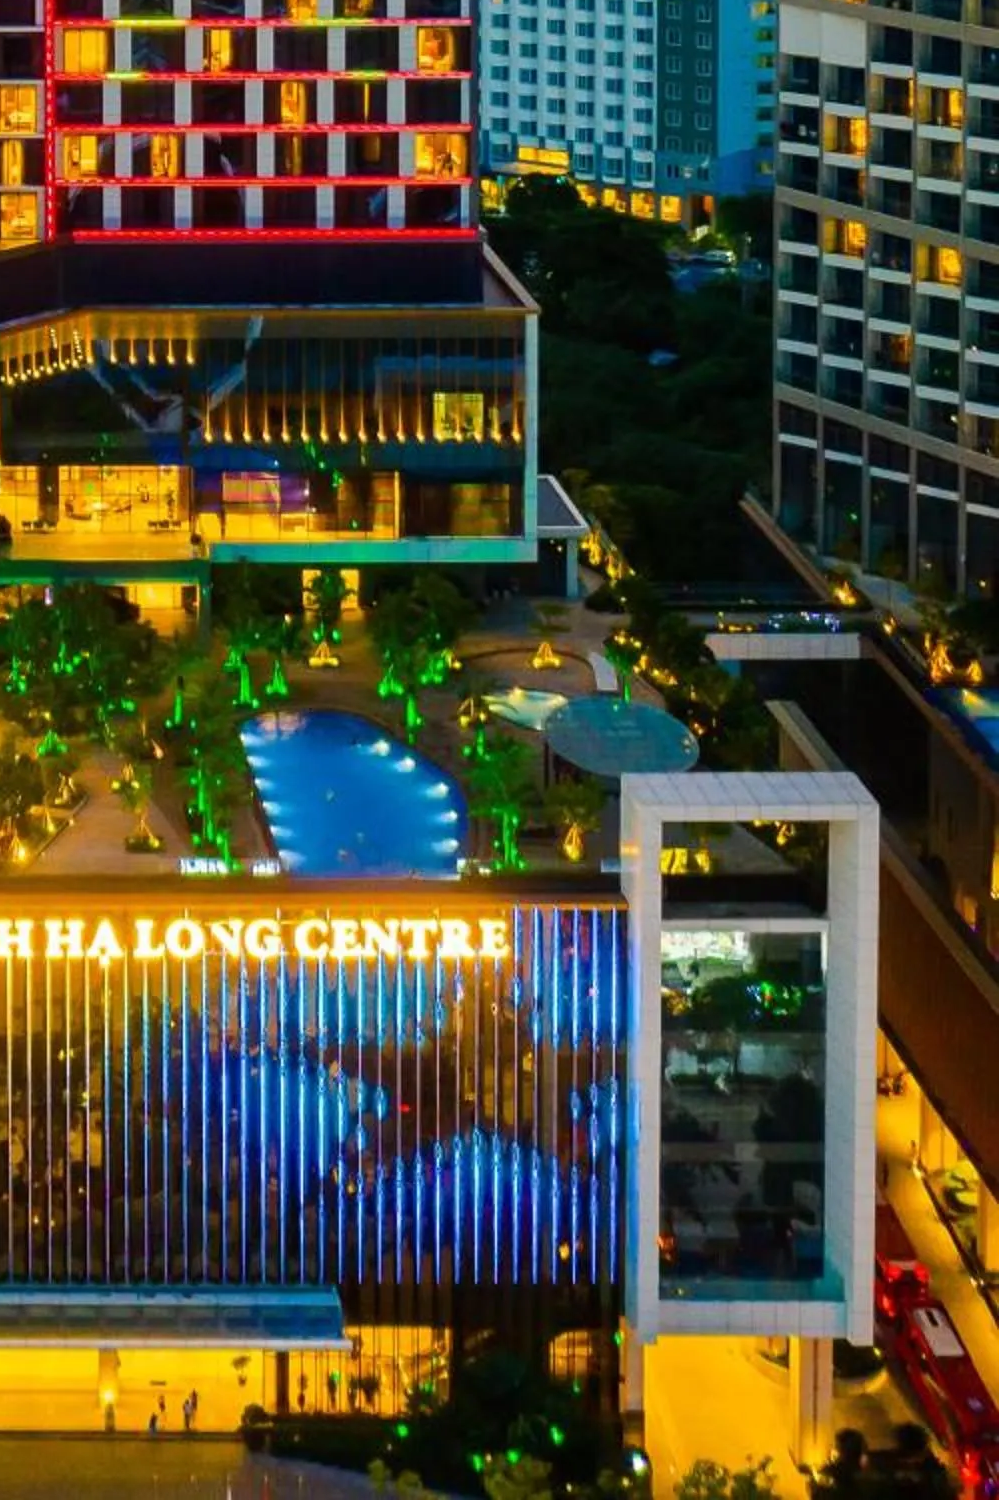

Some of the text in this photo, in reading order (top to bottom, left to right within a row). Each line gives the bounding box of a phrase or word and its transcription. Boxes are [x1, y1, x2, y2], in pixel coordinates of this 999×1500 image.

[43, 917, 124, 967] HẠ
[133, 917, 282, 959] LONG
[293, 917, 511, 959] CENTRE
